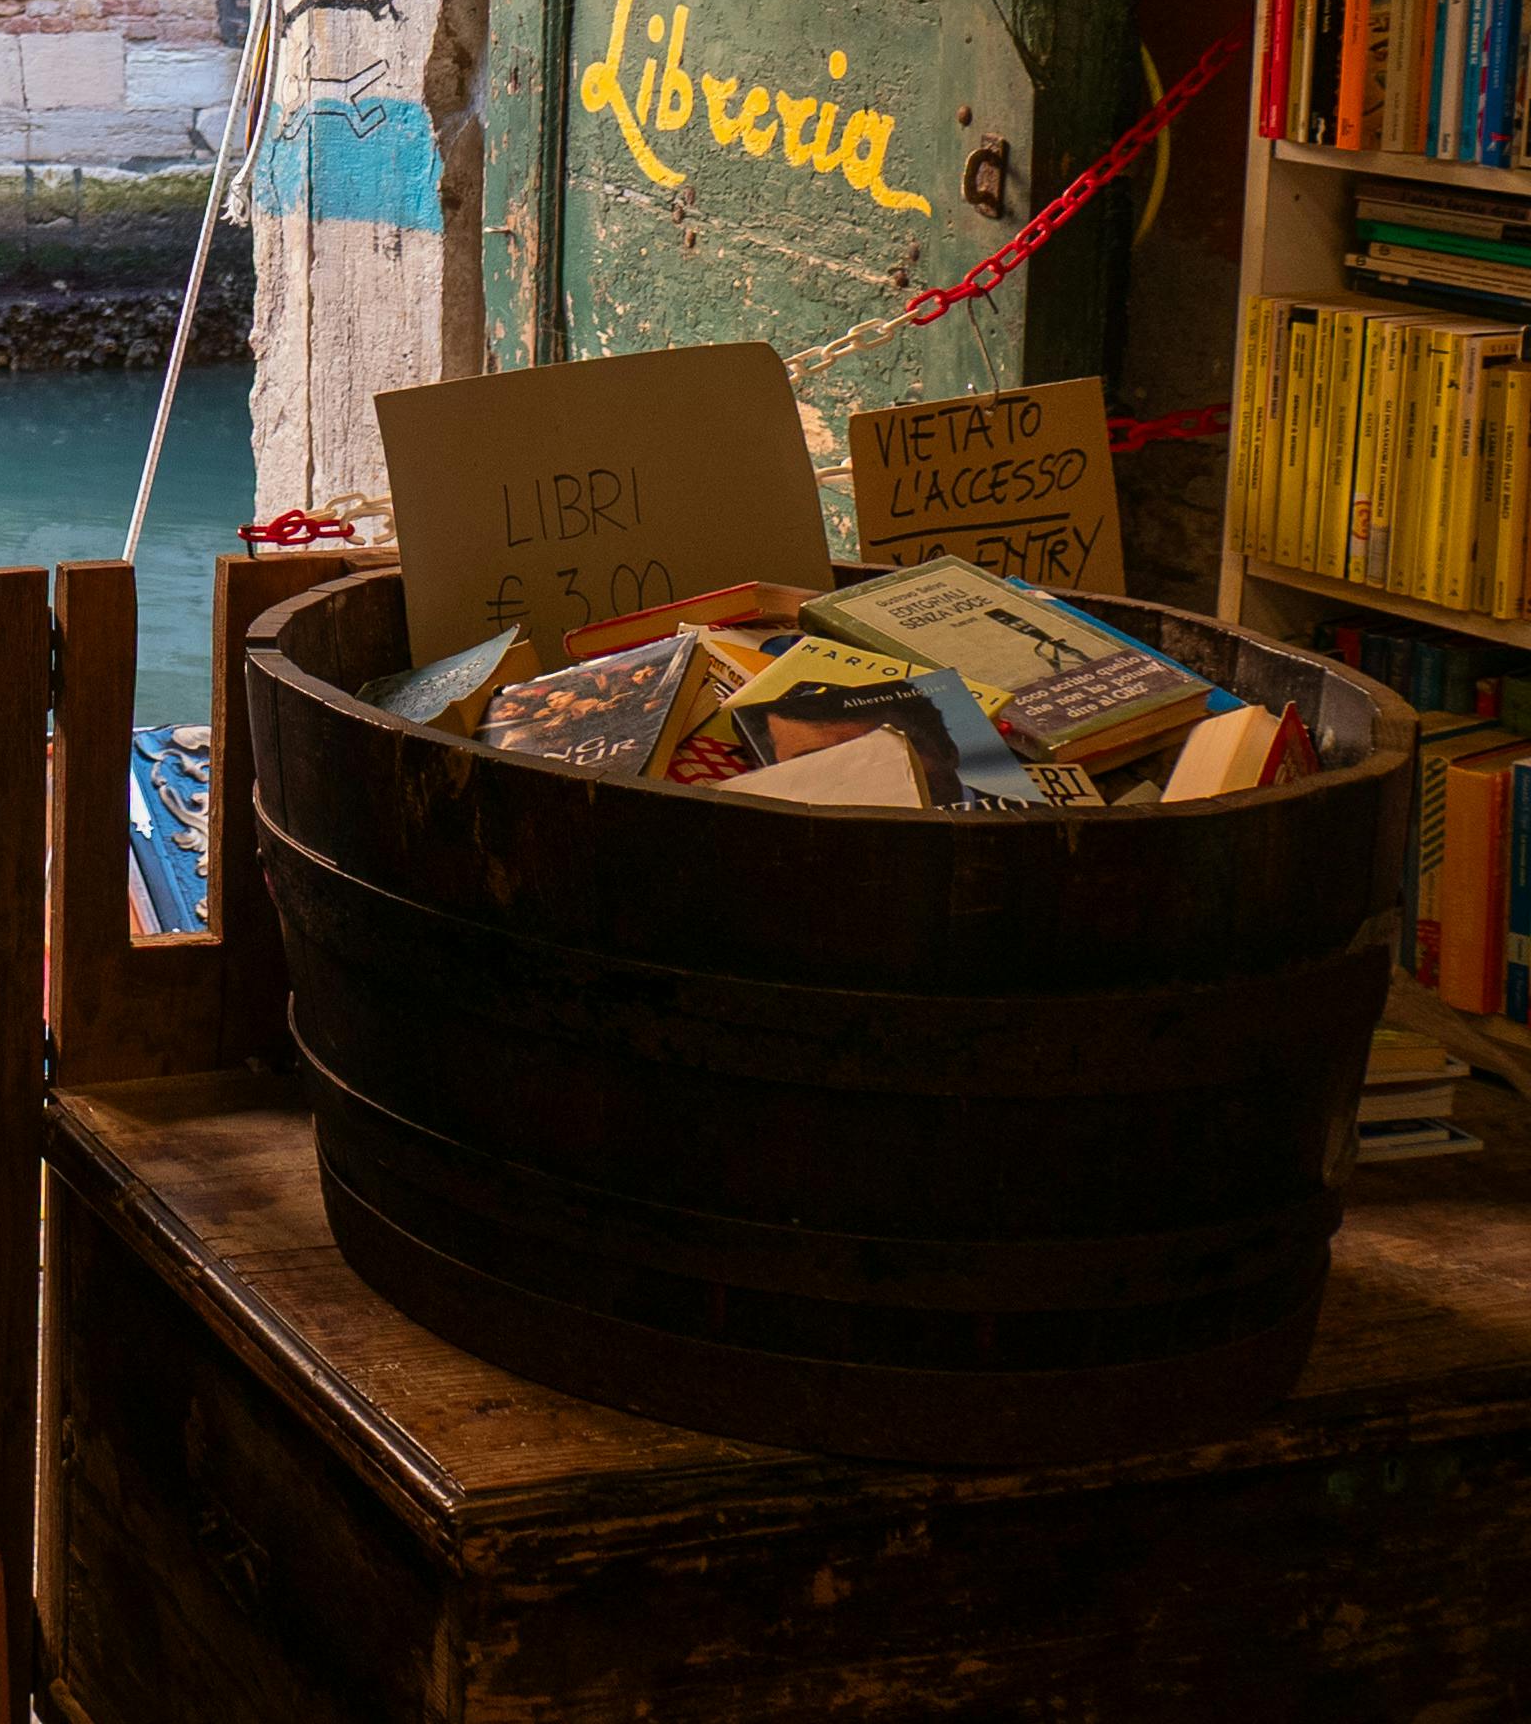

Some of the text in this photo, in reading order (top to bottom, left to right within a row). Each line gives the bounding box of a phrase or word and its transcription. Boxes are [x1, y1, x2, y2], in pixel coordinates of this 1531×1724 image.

[874, 396, 1043, 467] VIETATO
[891, 448, 1088, 519] L'ACCESSO
[503, 466, 642, 548] LIBRI
[887, 586, 970, 620] EDITORIALI
[898, 593, 994, 632] SENZA VOCE
[801, 642, 900, 676] MARIO
[1049, 669, 1096, 699] scritto
[1096, 655, 1142, 681] quello
[1024, 701, 1054, 719] che
[1054, 689, 1084, 710] non
[1087, 680, 1109, 697] ho
[1066, 702, 1098, 719] dire
[1098, 693, 1117, 712] al
